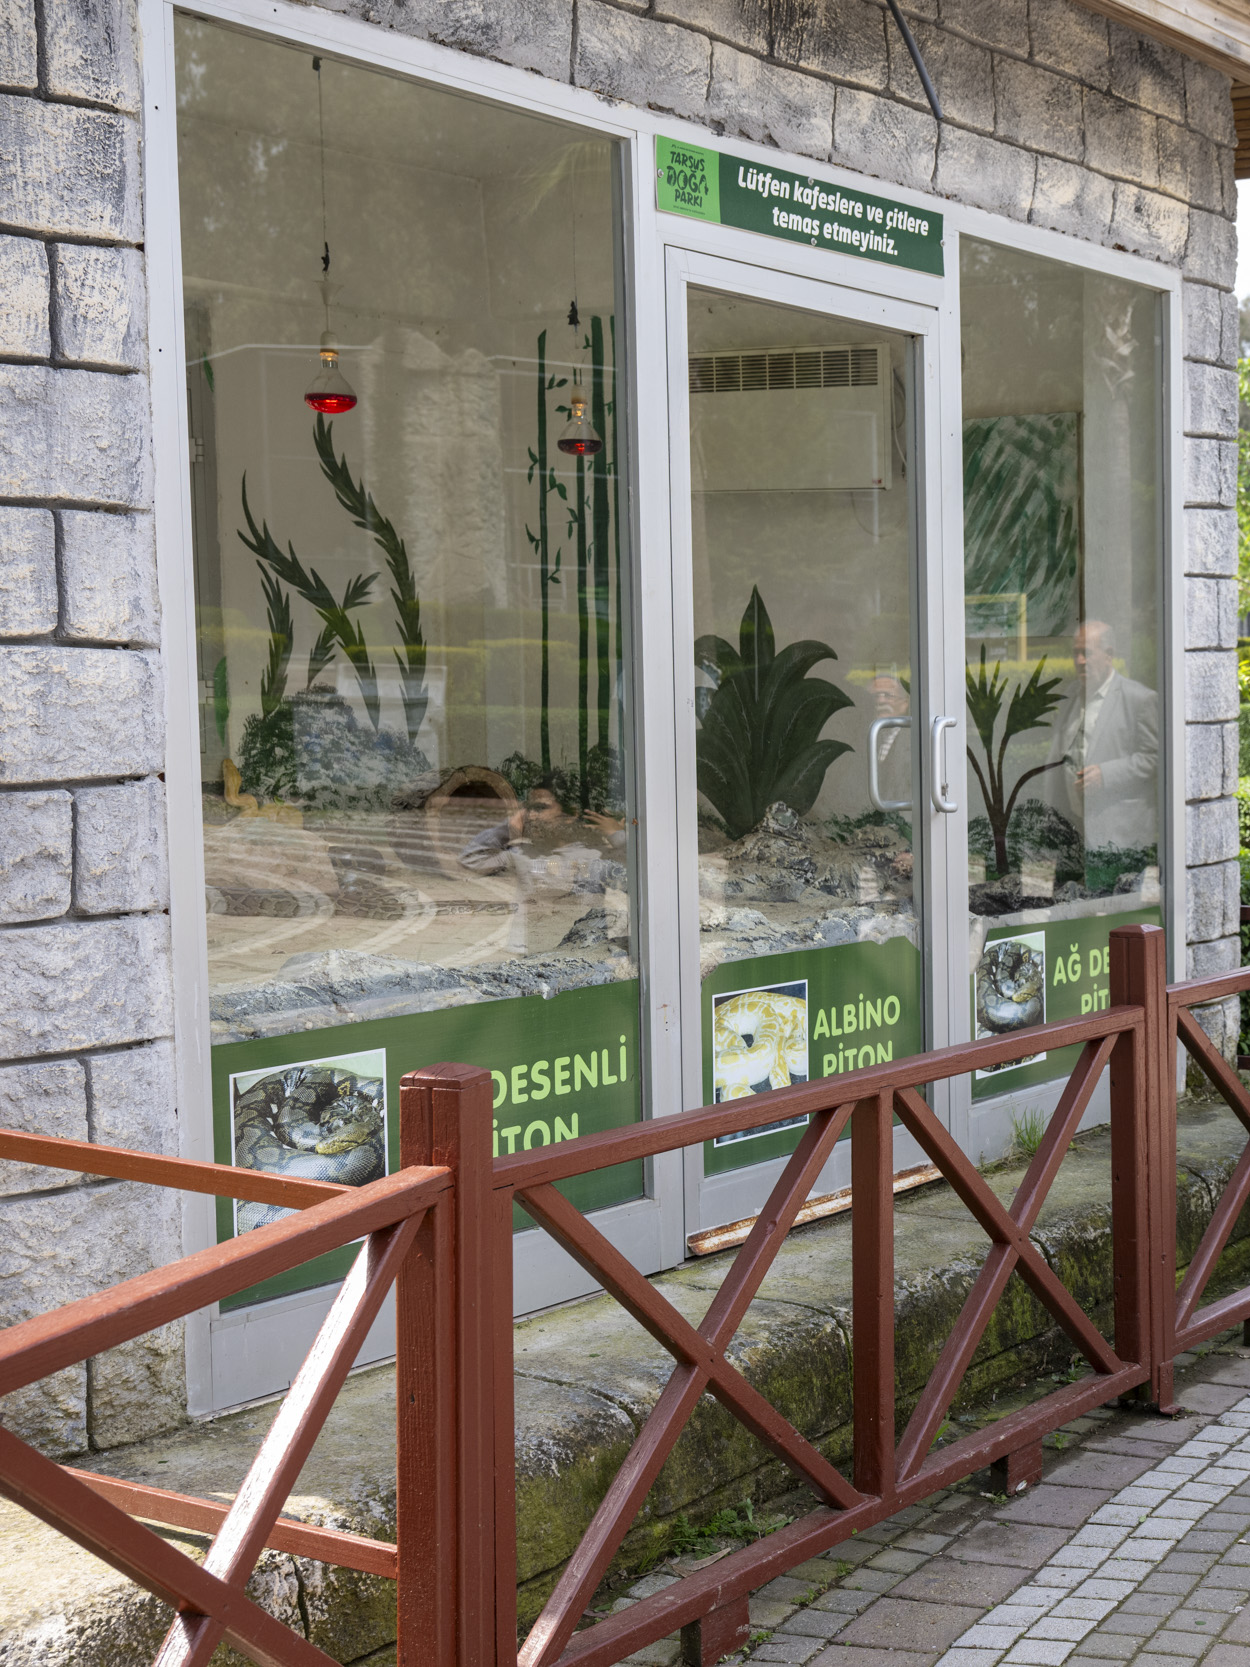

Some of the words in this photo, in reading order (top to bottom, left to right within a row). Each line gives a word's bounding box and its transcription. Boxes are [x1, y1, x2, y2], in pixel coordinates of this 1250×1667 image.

[667, 166, 709, 196] DOĞA
[670, 151, 705, 172] TARSUS
[674, 189, 703, 208] PARKI
[738, 166, 791, 199] Lütfen
[793, 181, 863, 218] kafeslere
[866, 205, 884, 225] ve
[886, 208, 929, 236] çitlere
[772, 206, 820, 236] temas
[823, 223, 898, 256] etmeyiniz.
[1052, 942, 1082, 986] AĞ
[1089, 945, 1110, 977] DE
[813, 993, 901, 1041] ALBİNO
[1081, 983, 1110, 1015] PİT
[490, 1034, 627, 1109] DESENLİ
[823, 1040, 894, 1078] PİTON
[493, 1112, 579, 1158] İTON
